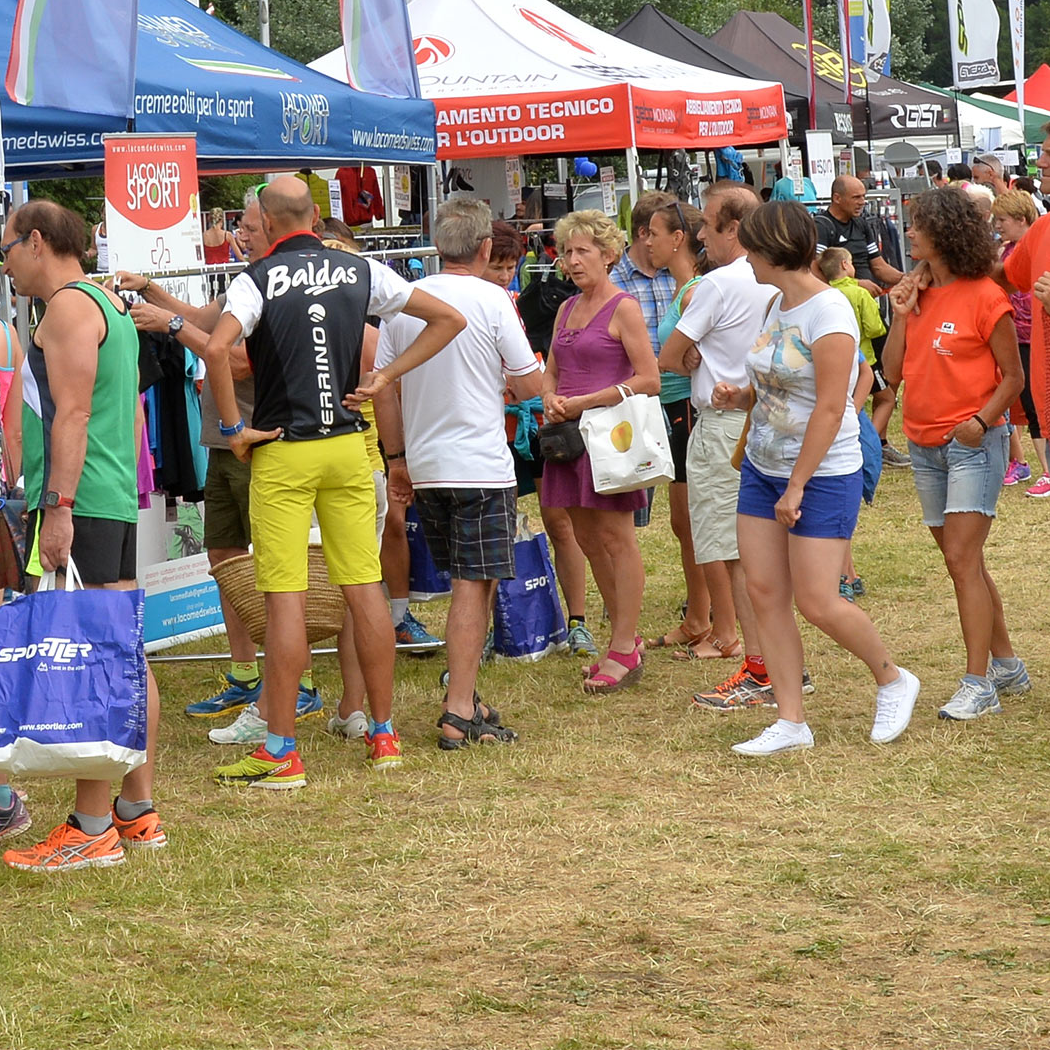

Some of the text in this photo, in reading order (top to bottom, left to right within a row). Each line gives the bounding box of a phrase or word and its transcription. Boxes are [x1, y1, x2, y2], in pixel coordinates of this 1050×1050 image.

[421, 74, 558, 86] OUNTAIN
[197, 99, 215, 123] per
[216, 91, 227, 117] lo
[228, 96, 254, 124] sport
[280, 91, 329, 116] LACOMED
[436, 106, 521, 127] AMENTO
[527, 98, 614, 119] TECNICO
[280, 110, 329, 145] SPORT
[457, 124, 565, 146] L'OUTDOOR
[126, 162, 180, 183] LACOMED
[126, 178, 181, 210] SPORT
[267, 259, 358, 300] Baldas
[19, 722, 83, 732] www.sportler.com
